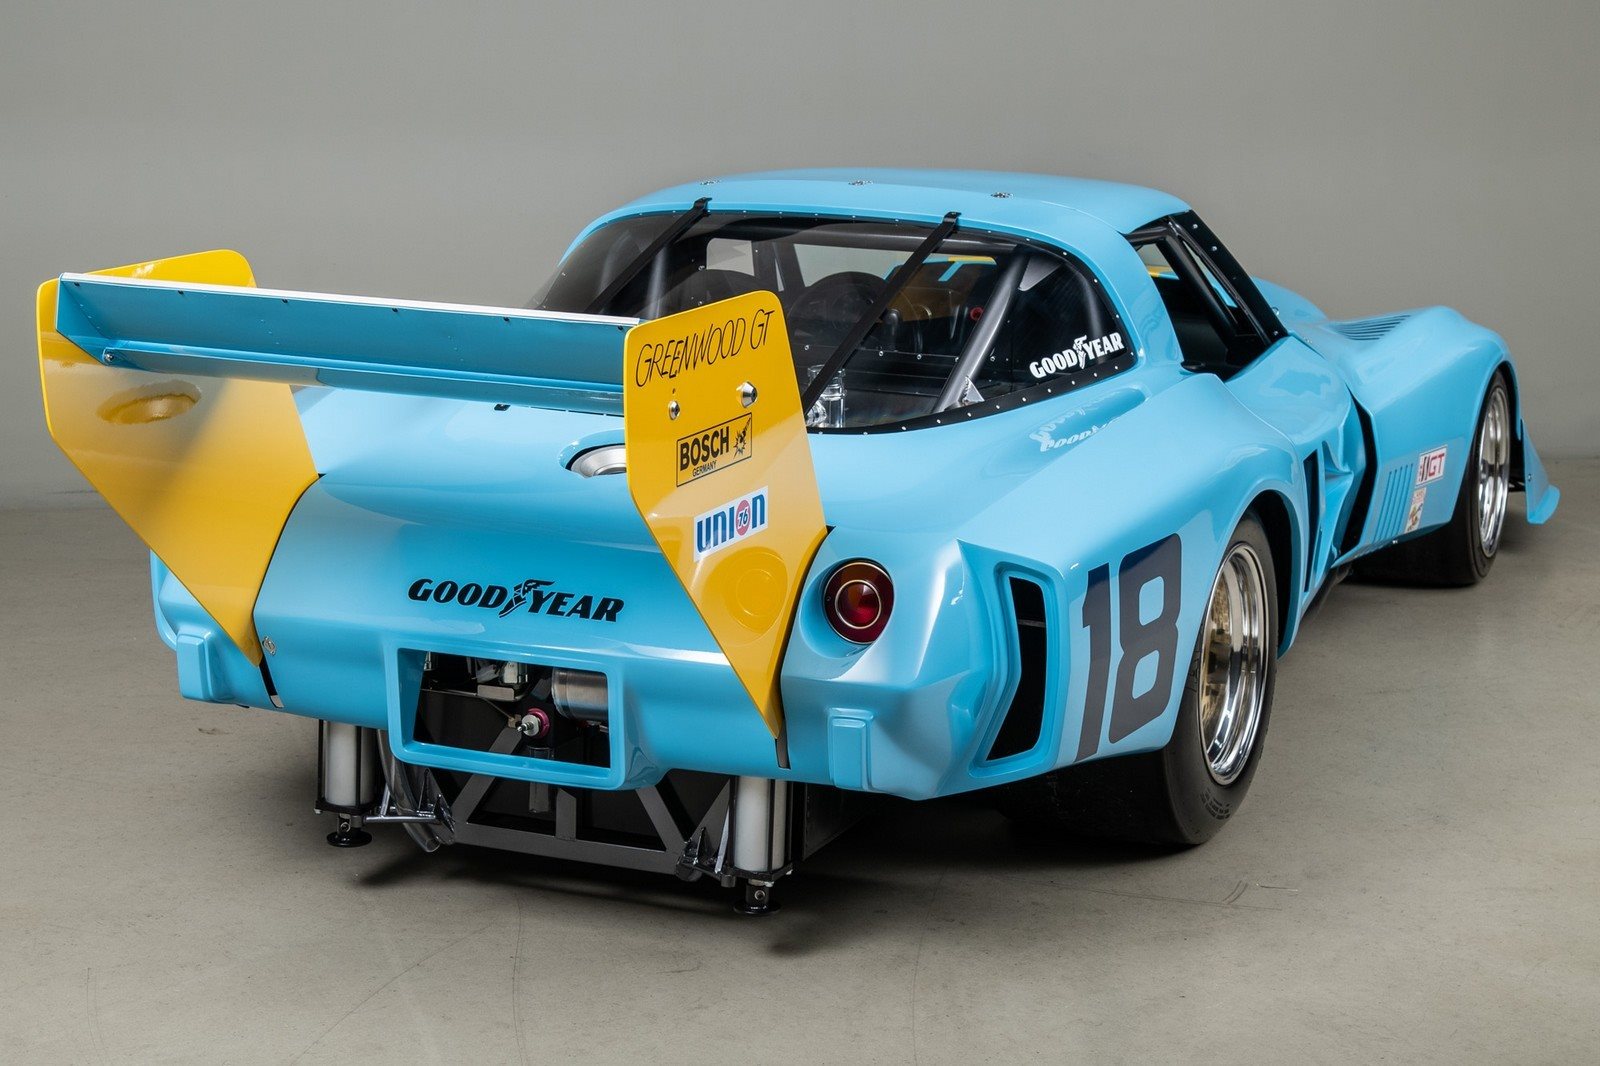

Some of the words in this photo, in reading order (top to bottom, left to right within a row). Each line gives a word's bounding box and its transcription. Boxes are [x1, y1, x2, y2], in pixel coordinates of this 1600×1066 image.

[635, 317, 746, 388] GREENWOOD
[750, 308, 775, 350] GT
[1029, 332, 1125, 379] GOODYEAR
[679, 426, 730, 472] BOSCH
[692, 460, 717, 477] GERMANY
[408, 578, 625, 622] GOODYEAR
[1074, 533, 1182, 763] 18
